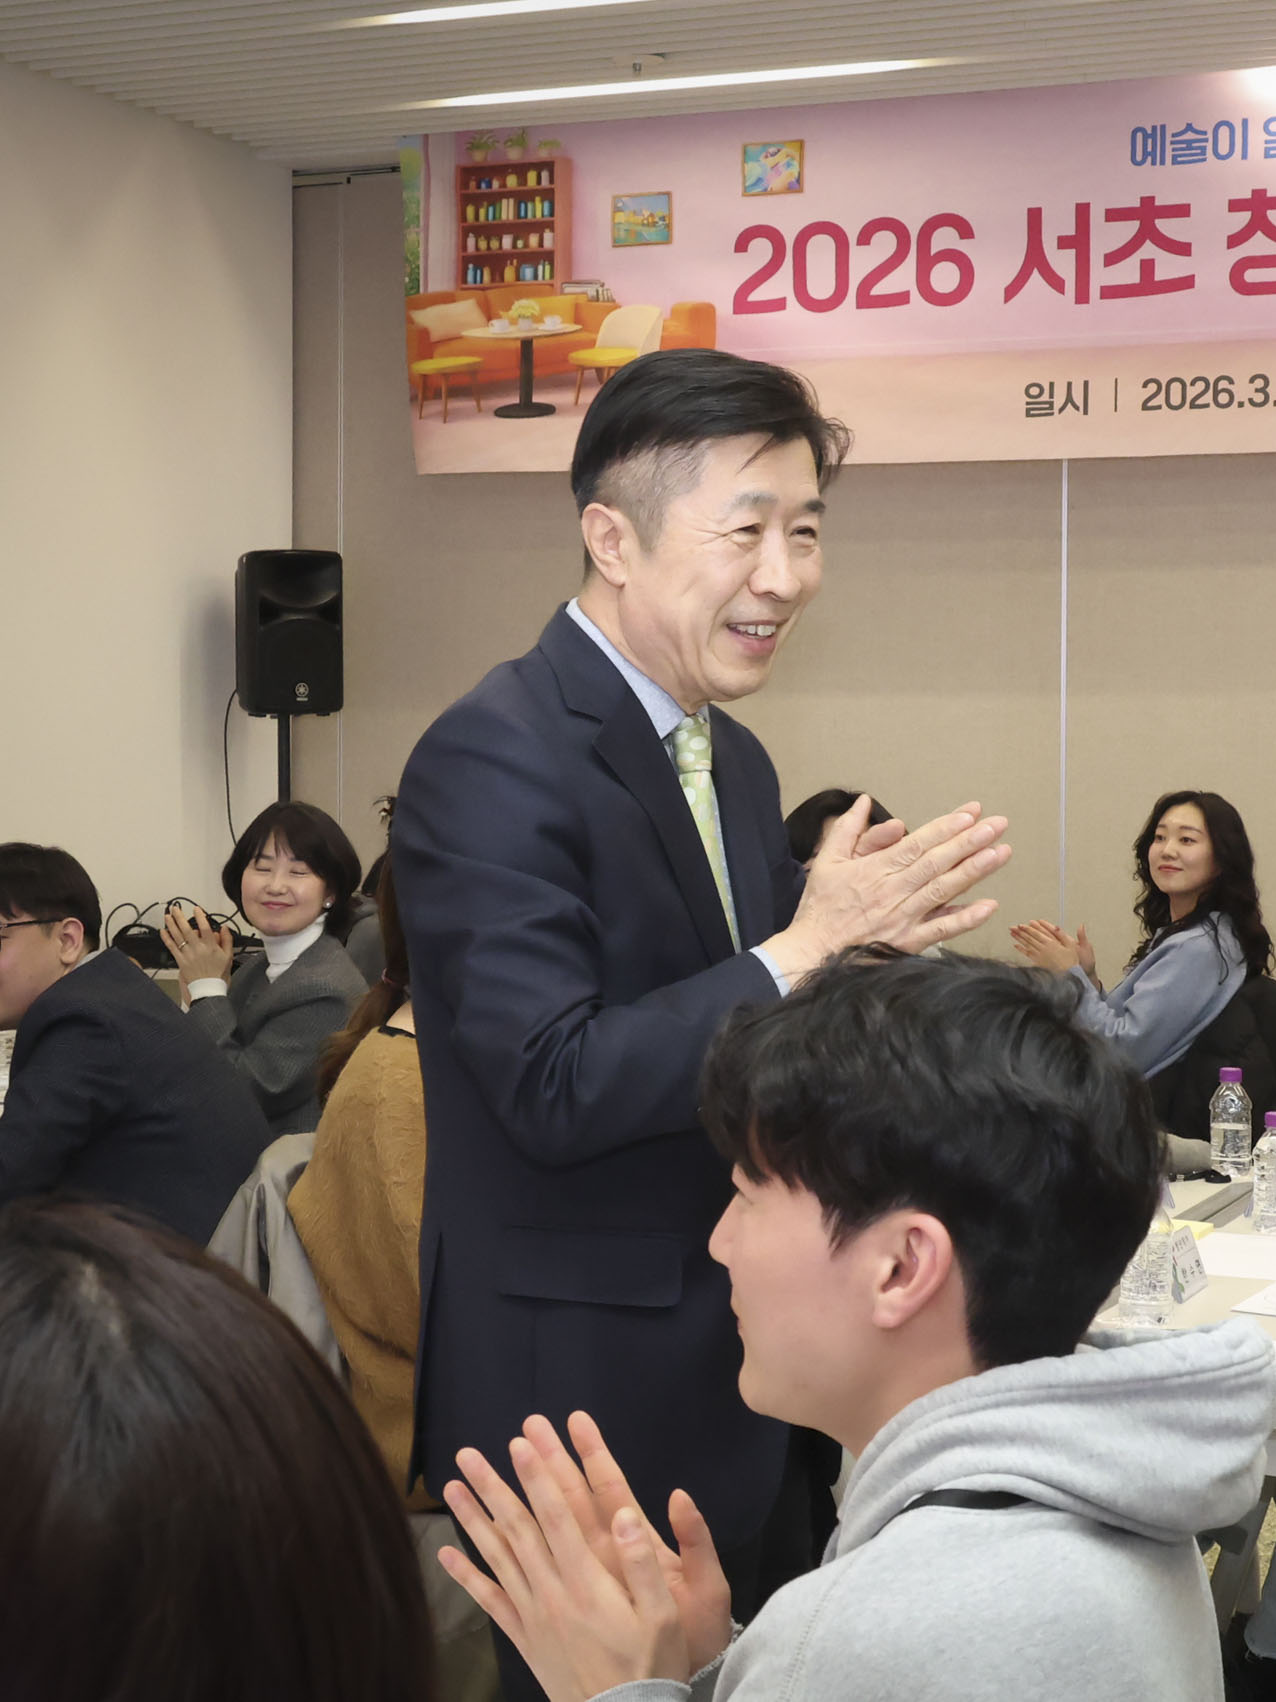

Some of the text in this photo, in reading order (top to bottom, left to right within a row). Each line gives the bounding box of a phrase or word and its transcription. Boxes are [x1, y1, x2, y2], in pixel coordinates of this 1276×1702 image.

[1130, 117, 1250, 167] 예술이
[732, 212, 976, 316] 2026
[1003, 195, 1196, 305] 서초
[1024, 379, 1090, 418] 일시
